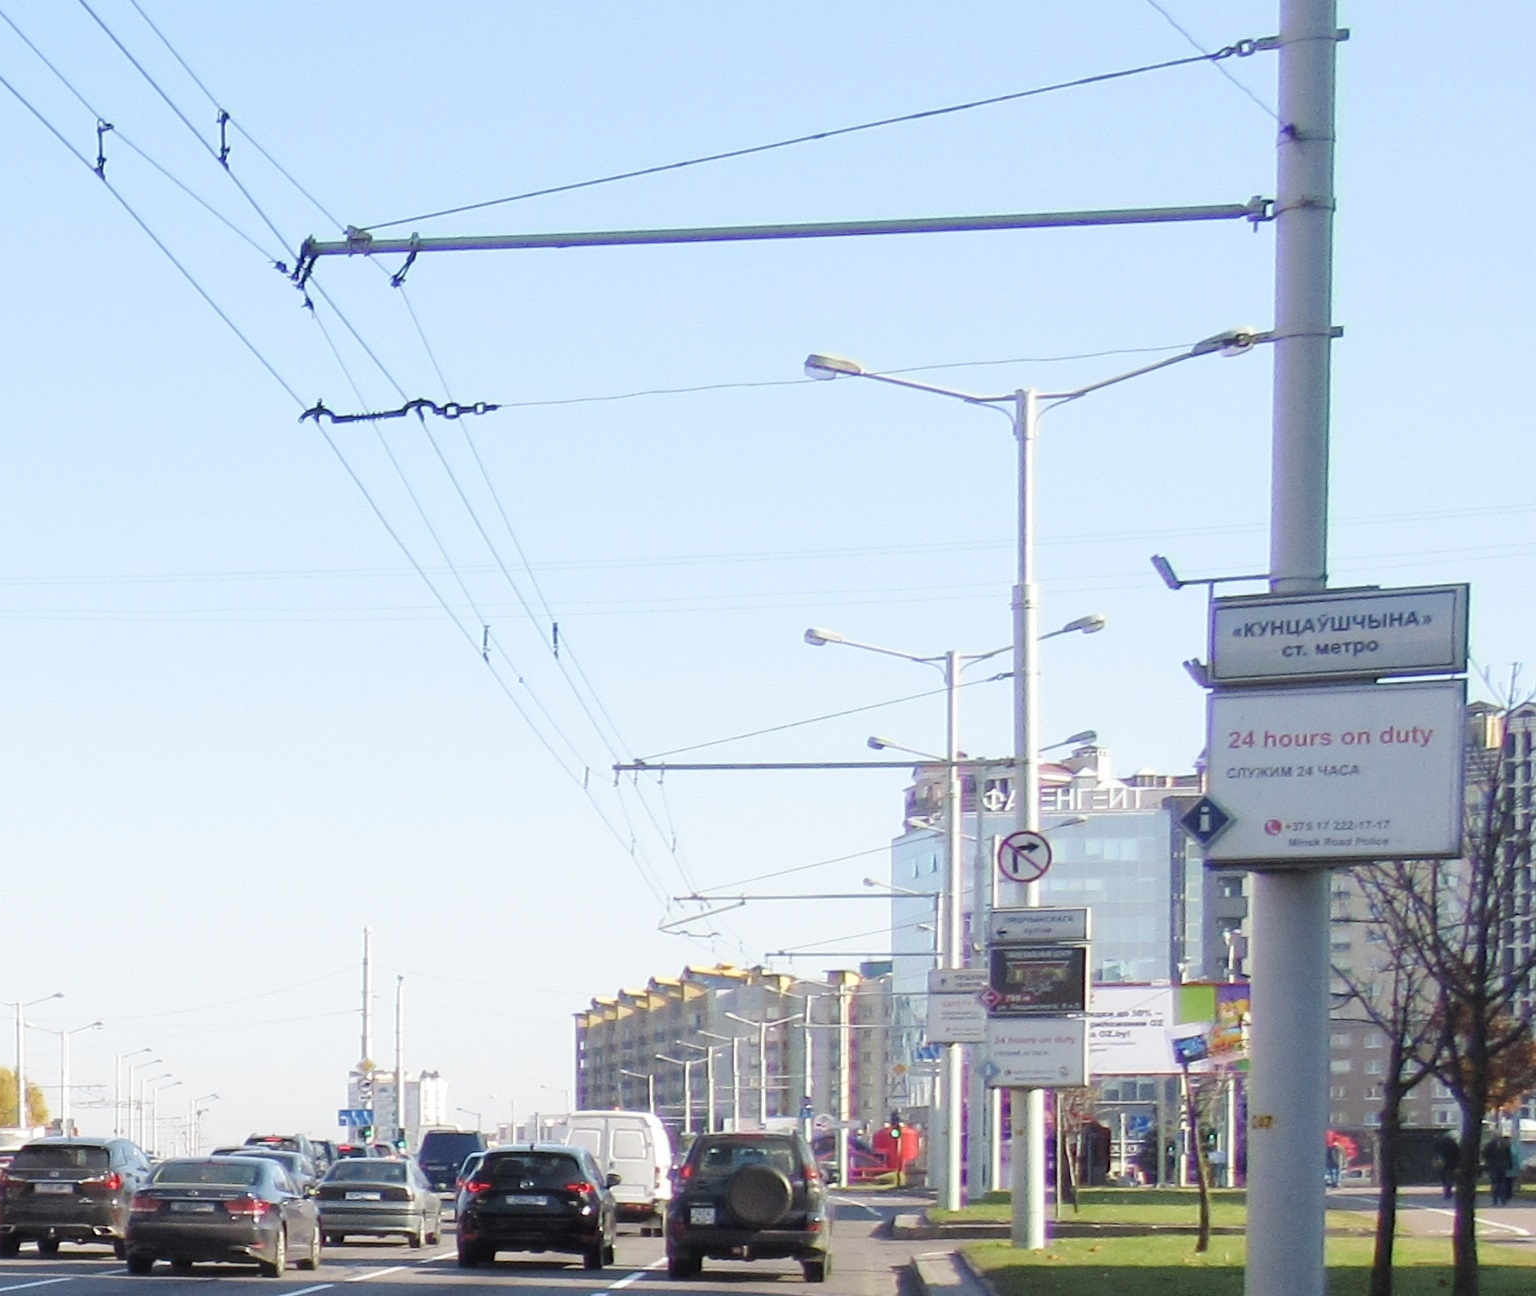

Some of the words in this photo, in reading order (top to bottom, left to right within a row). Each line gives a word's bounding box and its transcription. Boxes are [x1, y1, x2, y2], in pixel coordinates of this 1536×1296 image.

[1232, 611, 1433, 638] «КУНЦАЎШЧЫНА»
[1282, 644, 1307, 657] ст.
[1314, 640, 1379, 657] метро
[1228, 730, 1255, 748] 24
[1264, 730, 1332, 748] hours
[1341, 731, 1370, 746] on
[1380, 725, 1433, 748] duty
[1227, 766, 1293, 779] СЛУЖИМ
[1297, 766, 1312, 777] 24
[1318, 764, 1359, 776] ЧАСА
